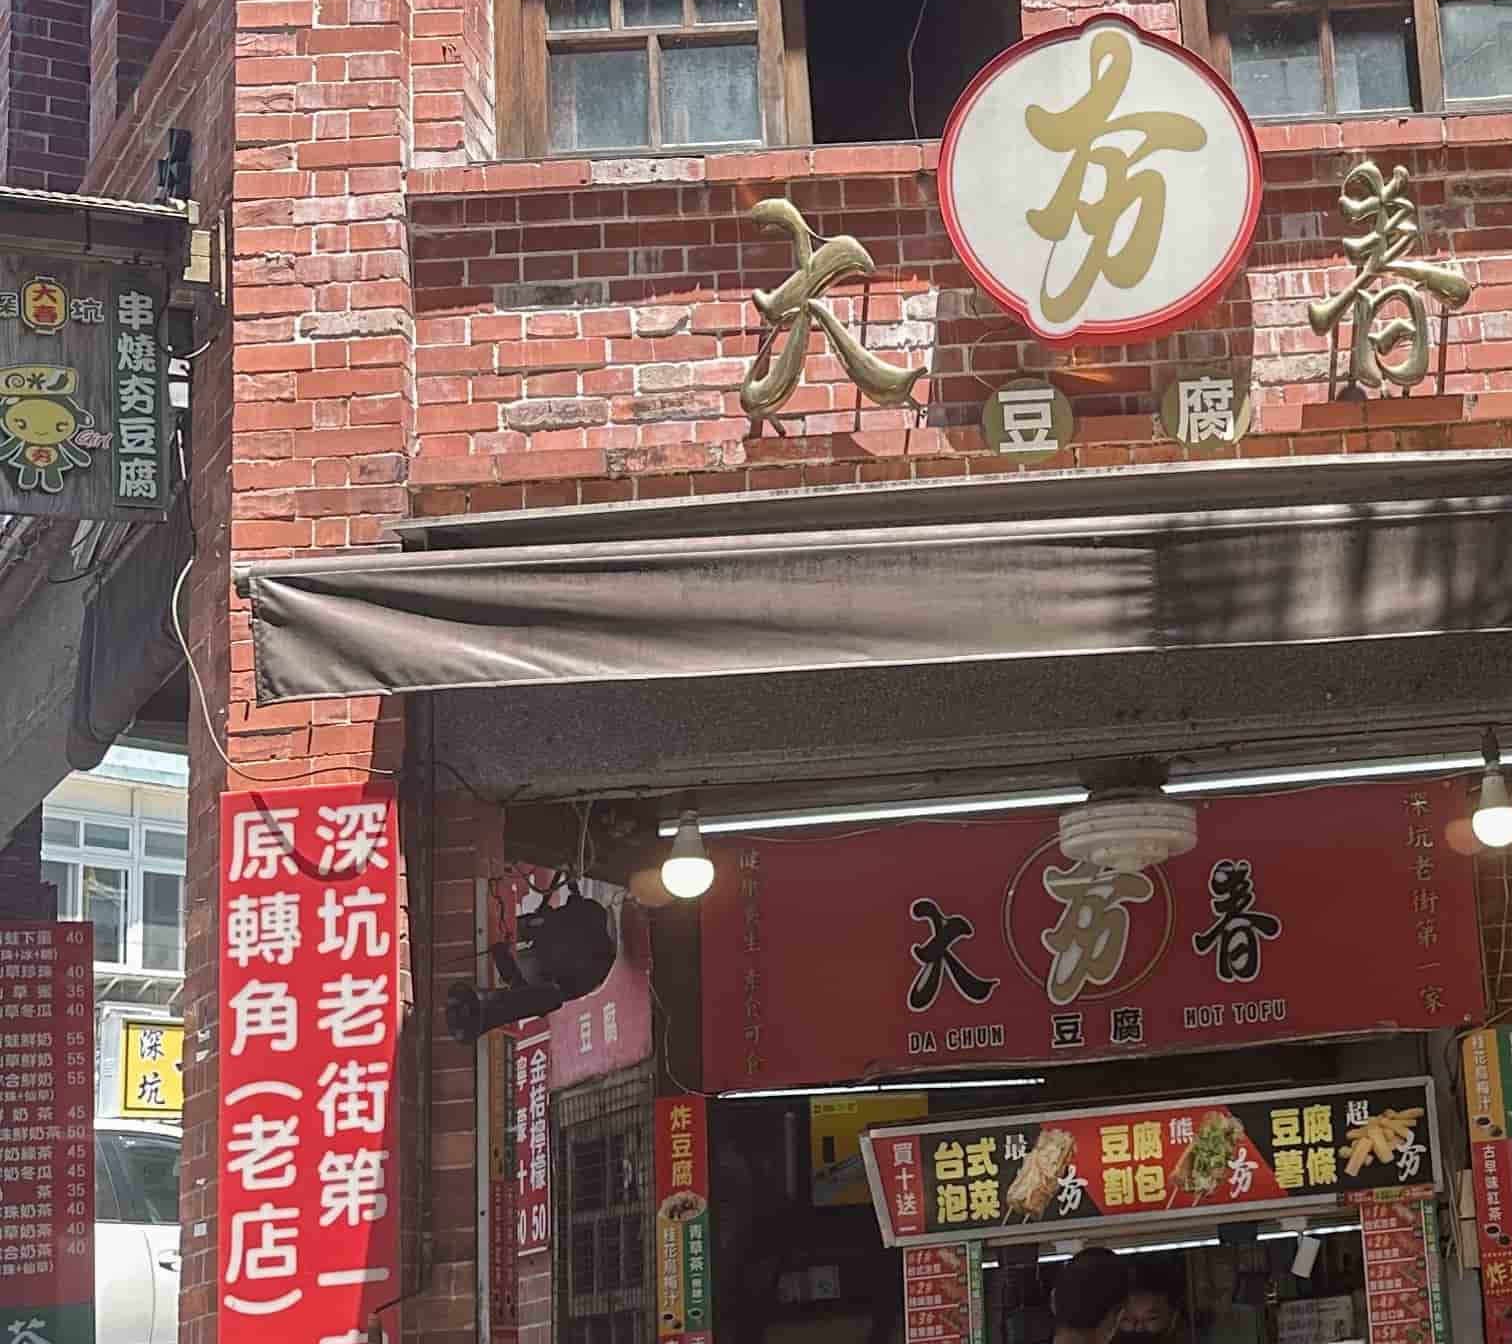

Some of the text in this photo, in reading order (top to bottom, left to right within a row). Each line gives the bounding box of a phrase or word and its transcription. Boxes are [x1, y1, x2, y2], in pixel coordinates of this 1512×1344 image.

[740, 197, 929, 436] 大
[117, 290, 158, 500] 串燒夯豆腐
[998, 376, 1236, 456] 豆腐
[907, 898, 1000, 1012] 大
[1051, 1007, 1143, 1047] 豆腐
[1184, 999, 1286, 1030] HOT TOFU
[66, 1032, 85, 1046] 55
[66, 1053, 85, 1065] 55
[909, 1024, 1004, 1054] DA CHUN
[67, 1072, 86, 1085] 55
[138, 1029, 166, 1106] 深坑
[67, 1106, 85, 1119] 45
[1270, 1104, 1332, 1148] 豆腐
[1344, 1099, 1370, 1127] 超
[67, 1145, 86, 1158] 45
[669, 1104, 693, 1188] 炸豆腐
[934, 1138, 998, 1181] 台式
[1004, 1134, 1031, 1161] 最
[1100, 1121, 1162, 1164] 豆腐
[67, 1165, 86, 1177] 45
[892, 1142, 919, 1233] 買十送一
[1102, 1164, 1166, 1206] 割包
[1273, 1147, 1338, 1190] 薯條
[1482, 1144, 1502, 1223] 古早味紅茶
[67, 1184, 86, 1197] 35
[936, 1181, 1000, 1223] 泡菜
[531, 1204, 546, 1241] 50
